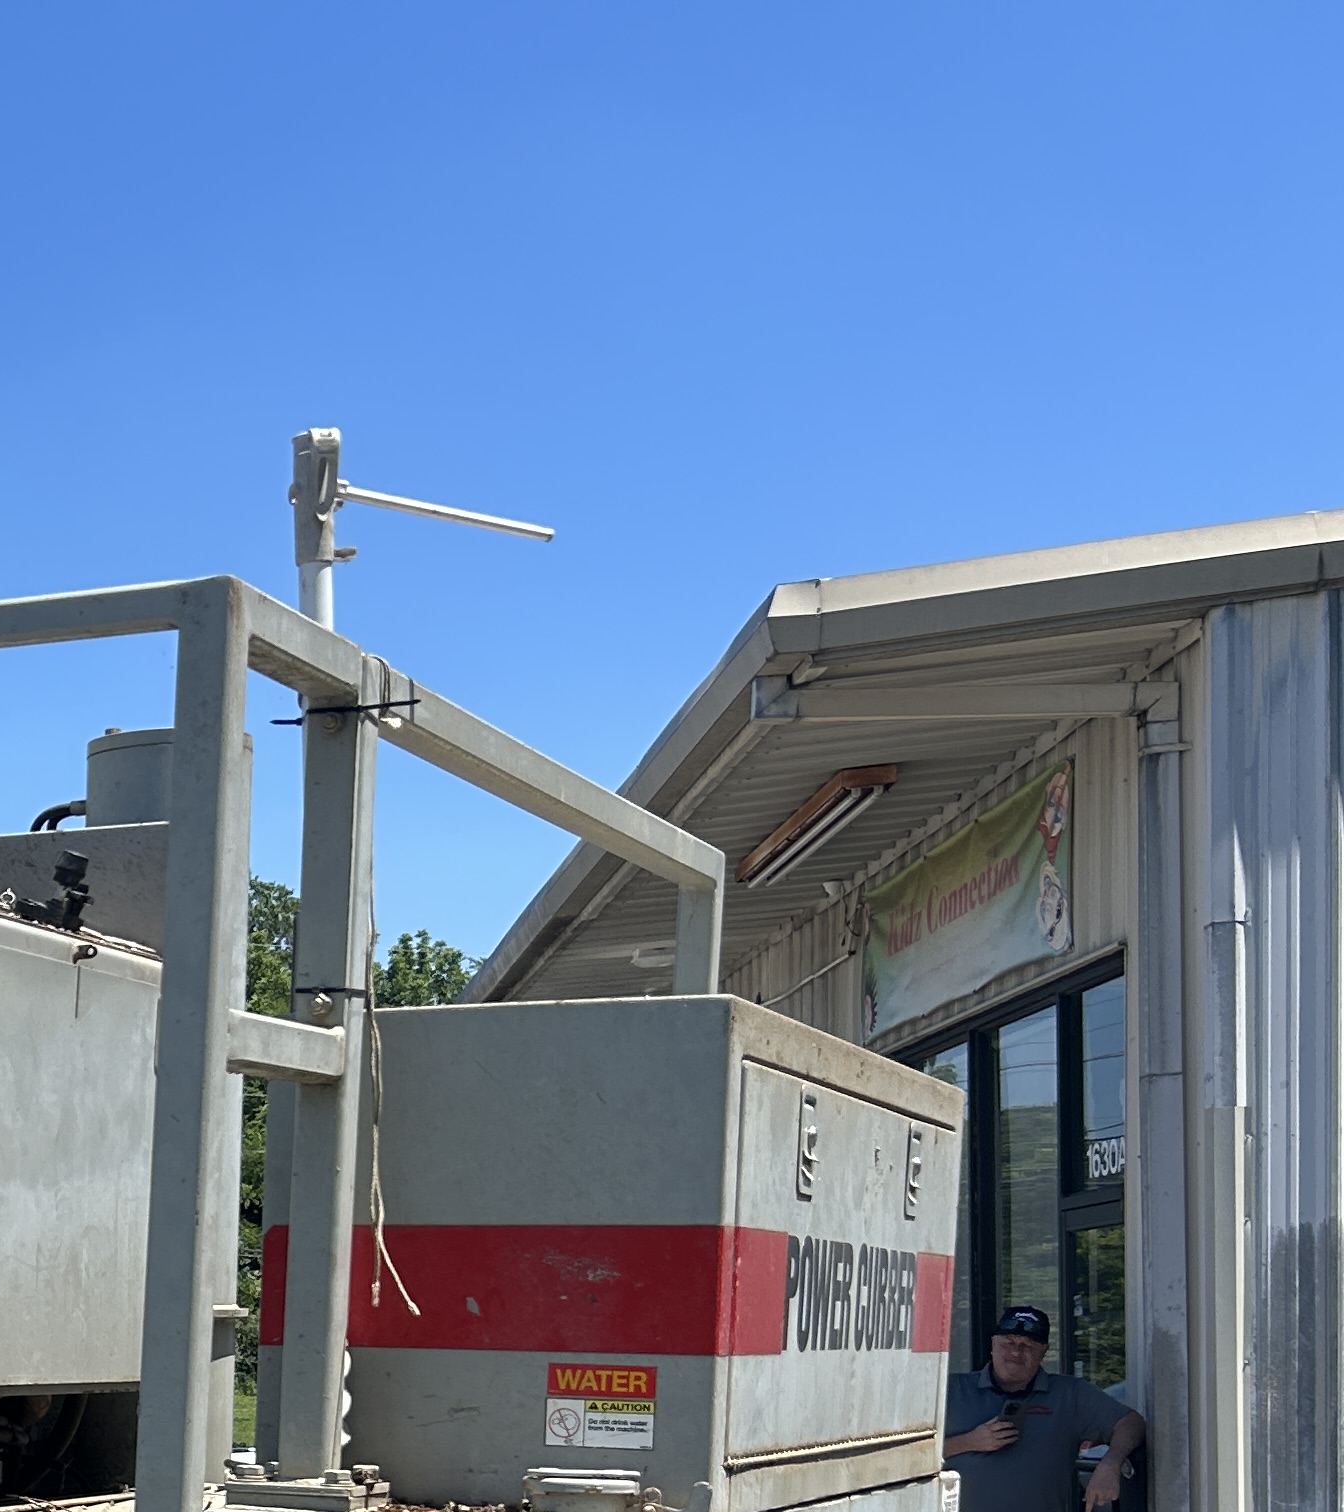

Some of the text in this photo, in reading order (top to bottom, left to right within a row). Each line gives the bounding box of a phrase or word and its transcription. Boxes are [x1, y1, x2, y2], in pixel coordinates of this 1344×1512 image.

[887, 852, 1021, 957] Kidz Connection
[782, 1234, 916, 1352] POWER CURBER
[555, 1368, 647, 1393] WATER
[601, 1402, 651, 1412] CAUTION
